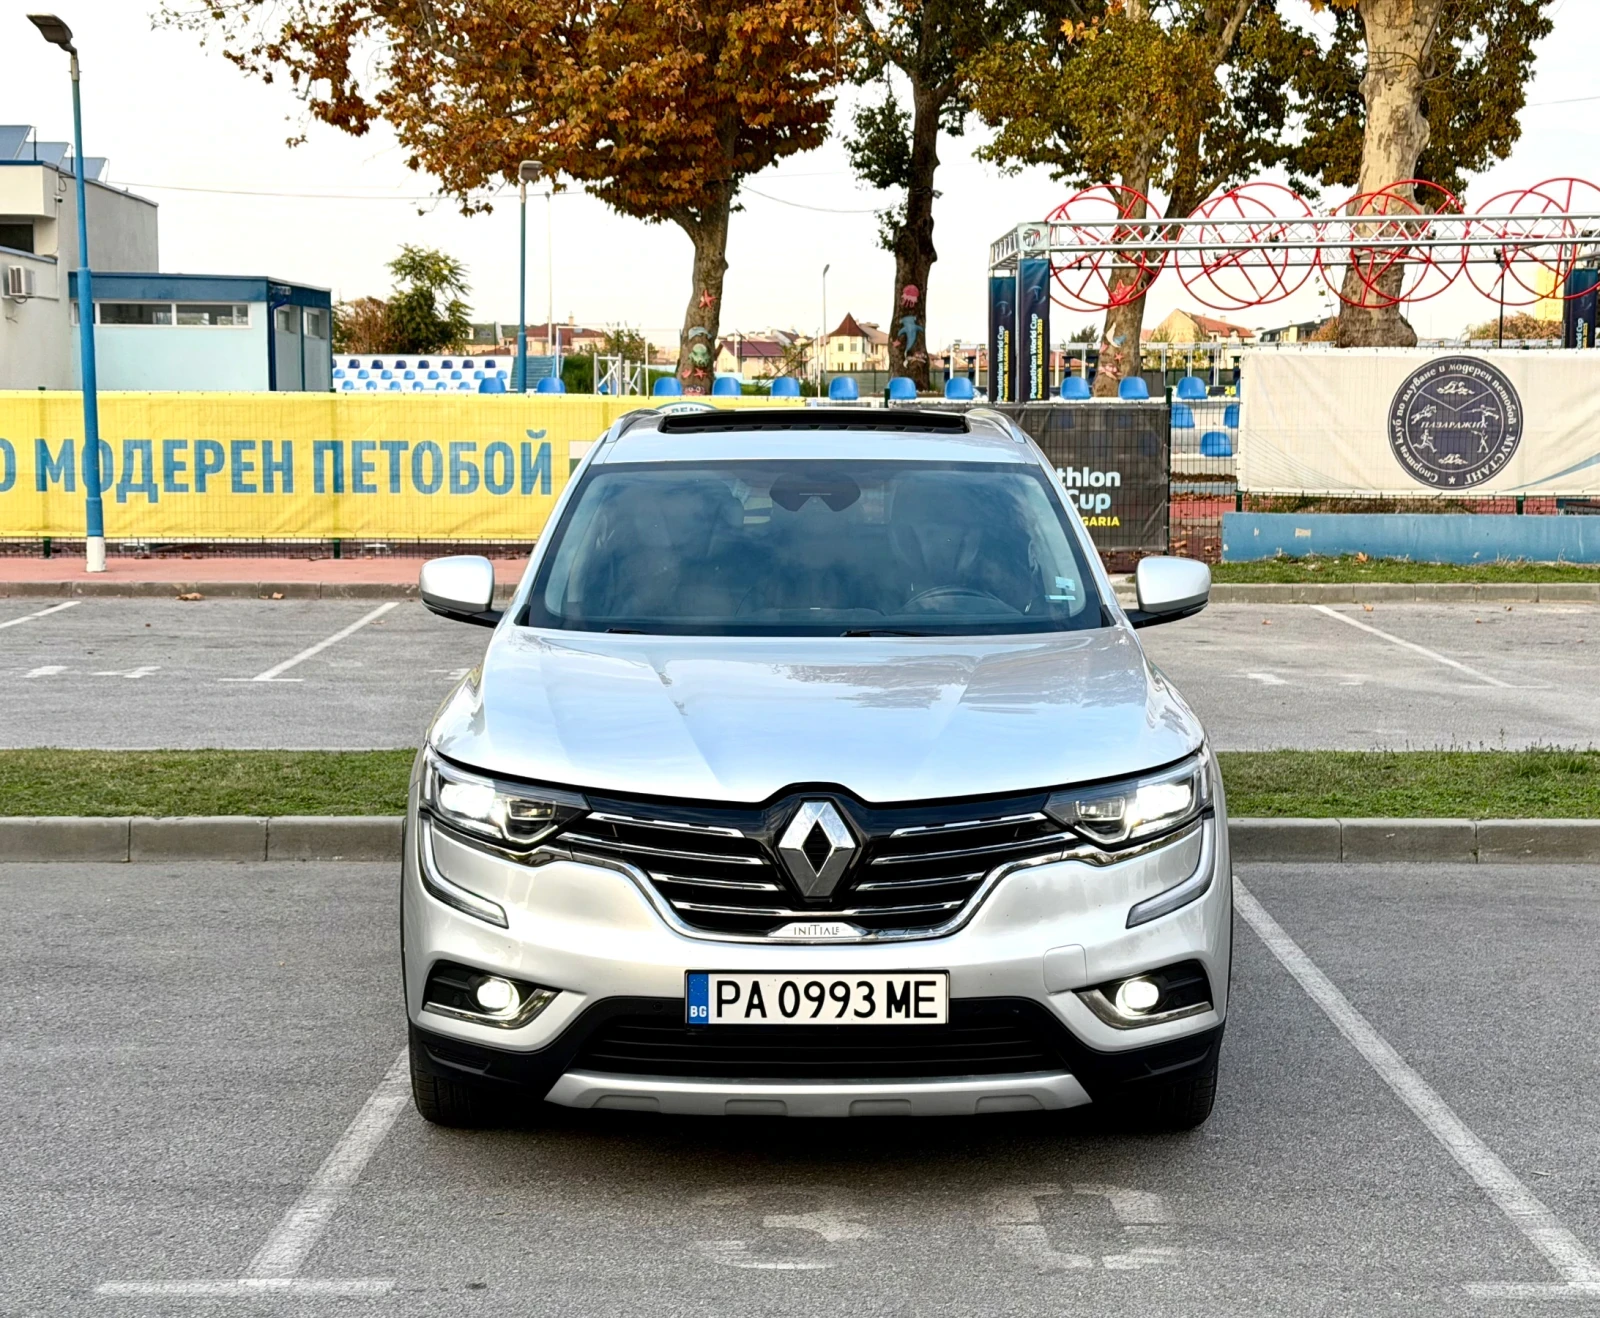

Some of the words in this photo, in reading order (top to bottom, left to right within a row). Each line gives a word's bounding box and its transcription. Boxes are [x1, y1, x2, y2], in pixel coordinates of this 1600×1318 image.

[1030, 313, 1038, 330] Cup
[997, 325, 1005, 340] Cup
[35, 438, 293, 503] МОДЕРЕН
[314, 429, 552, 495] ПЕТОБОЙ
[1464, 434, 1516, 486] МУСТАНГ
[793, 924, 840, 936] INITIALE
[716, 980, 767, 1019] PA
[778, 980, 876, 1019] 0993
[885, 980, 938, 1019] ME
[690, 1005, 707, 1018] BG
